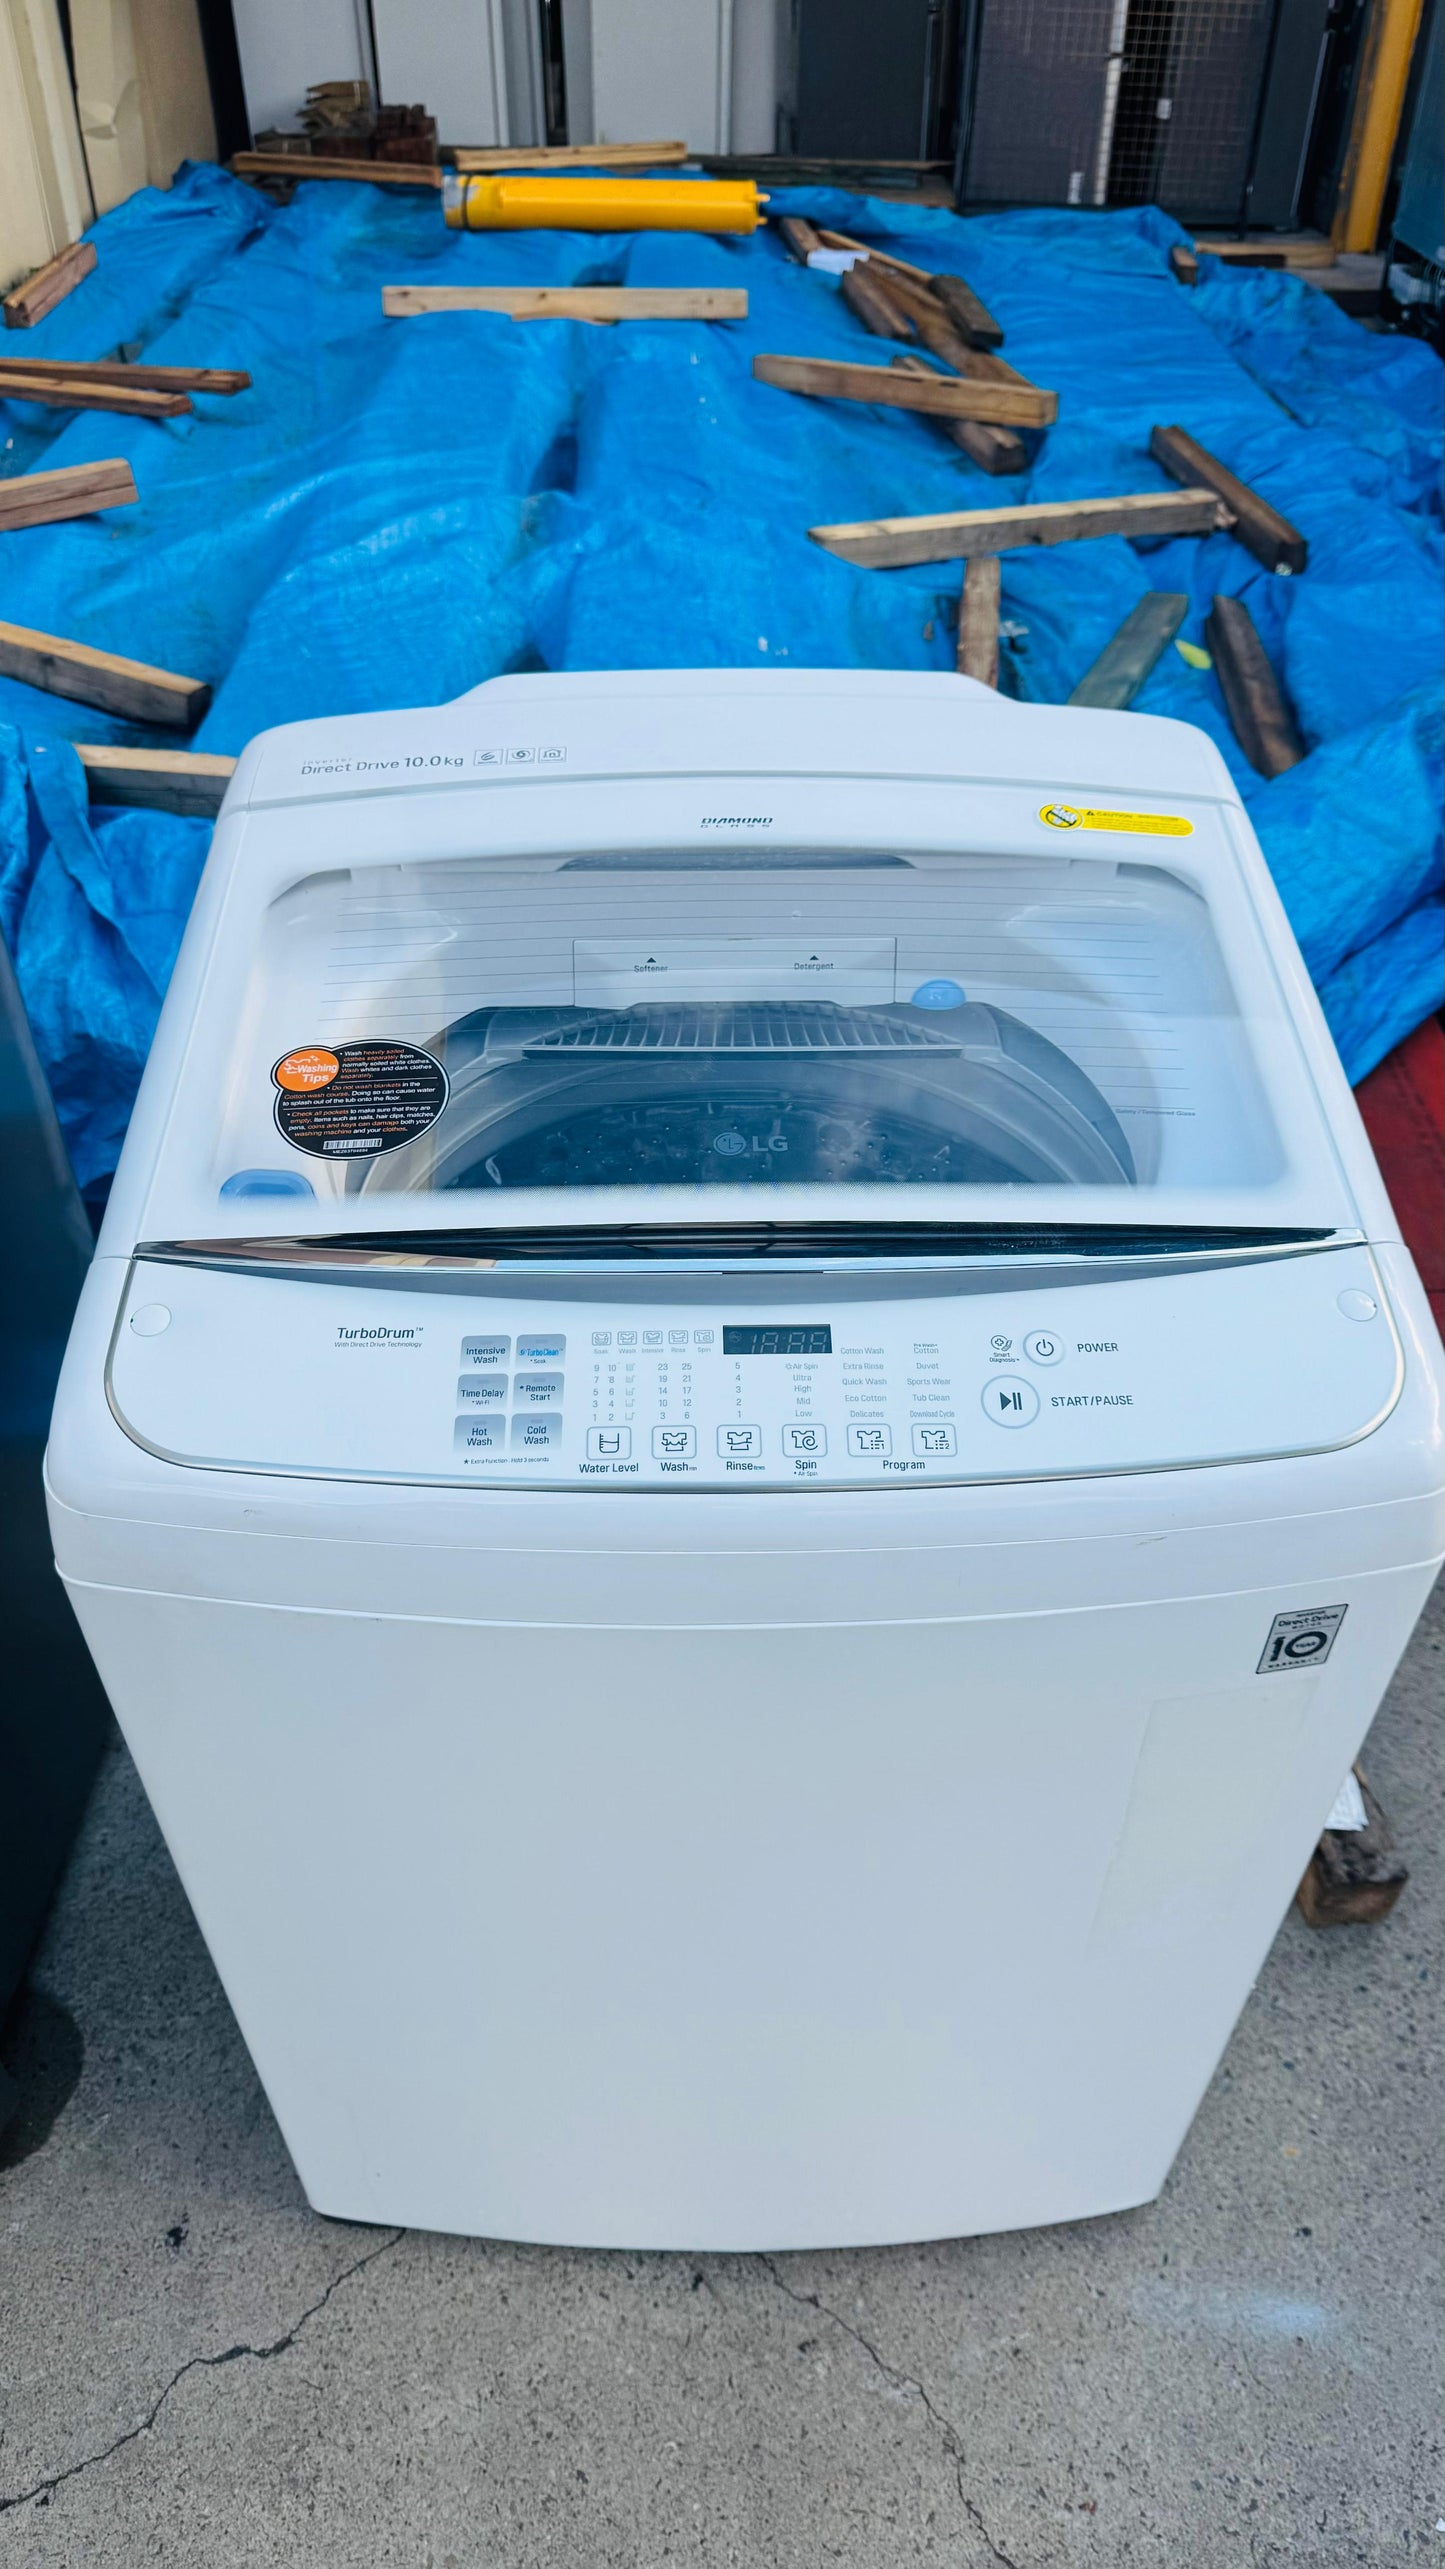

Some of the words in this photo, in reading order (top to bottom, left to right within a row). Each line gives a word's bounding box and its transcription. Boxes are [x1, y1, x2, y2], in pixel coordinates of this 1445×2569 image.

[301, 763, 352, 775] Direct
[357, 761, 400, 771] Drive
[634, 964, 668, 973] Softener
[794, 962, 834, 971] Detergent
[297, 1063, 338, 1074] Washing
[302, 1073, 329, 1084] Tips
[752, 1135, 788, 1152] LG
[387, 1341, 422, 1349] Technology
[1077, 1342, 1119, 1353] POWER
[466, 1347, 506, 1355] Intensive
[472, 1356, 498, 1364] Wash
[594, 1364, 600, 1372] 9
[608, 1364, 616, 1372] 10
[657, 1363, 668, 1371] 23
[681, 1363, 692, 1371] 25
[735, 1362, 740, 1370] 5
[803, 1363, 818, 1371] Spin
[843, 1362, 863, 1370] Extra
[864, 1362, 884, 1370] Rinse
[916, 1362, 939, 1370] Duvet
[609, 1376, 615, 1384] 8
[659, 1375, 668, 1383] 19
[682, 1375, 692, 1383] 21
[842, 1378, 863, 1386] Quick
[865, 1378, 887, 1386] Wash
[907, 1378, 931, 1387] Sports
[525, 1384, 556, 1392] Remote
[593, 1388, 599, 1396] 5
[609, 1388, 615, 1396] 6
[659, 1386, 668, 1394] 14
[683, 1386, 692, 1394] 17
[736, 1386, 741, 1394] 3
[794, 1385, 811, 1393] High
[461, 1389, 480, 1398] Time
[481, 1389, 505, 1399] Delay
[530, 1392, 551, 1401] Start
[844, 1394, 859, 1402] Eco
[861, 1394, 887, 1402] Cotton
[592, 1400, 598, 1408] 3
[659, 1399, 668, 1407] 10
[683, 1399, 692, 1407] 12
[736, 1398, 742, 1406] 2
[796, 1397, 811, 1405] Mid
[1051, 1395, 1134, 1407] START/PAUSE
[608, 1413, 614, 1421] 2
[850, 1410, 884, 1418] Delicates
[909, 1410, 938, 1418] Download
[939, 1410, 955, 1419] Cycle
[472, 1427, 488, 1436] Hot
[527, 1425, 547, 1434] Cold
[466, 1437, 493, 1446] Wash
[524, 1435, 550, 1445] Wash
[578, 1463, 610, 1473] Water
[612, 1462, 639, 1473] Level
[660, 1461, 689, 1472] Wash
[726, 1461, 753, 1471] Rinse
[795, 1460, 817, 1470] Spin
[882, 1460, 926, 1472] Program
